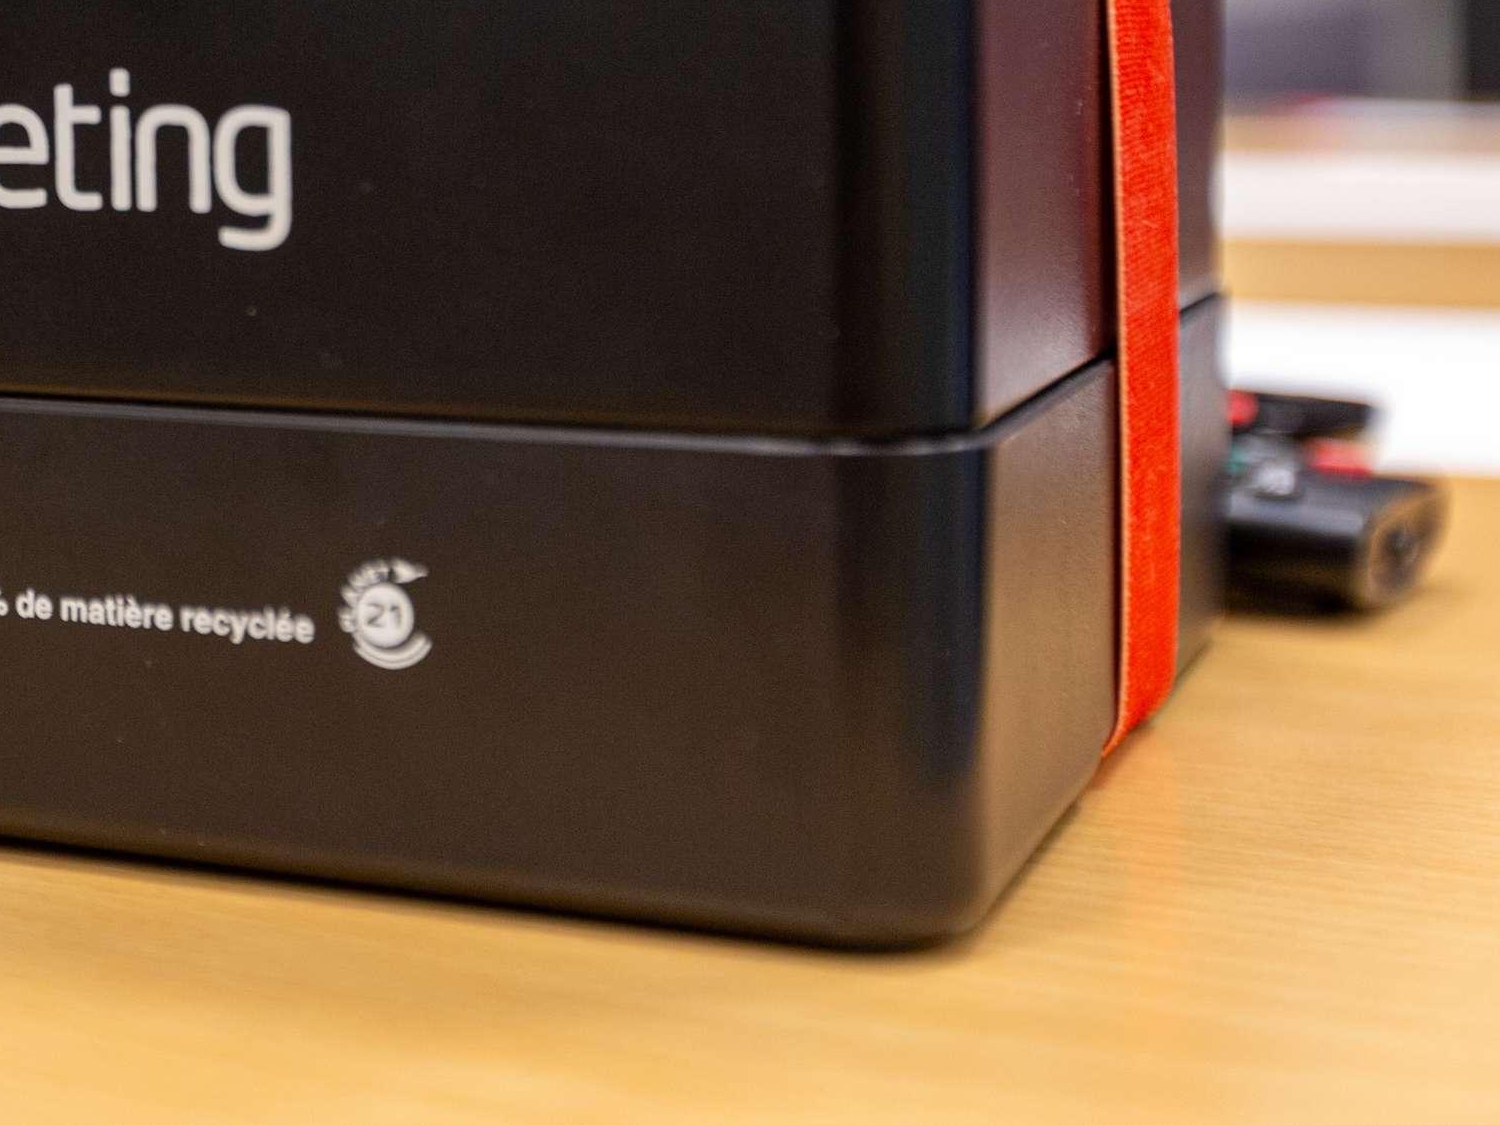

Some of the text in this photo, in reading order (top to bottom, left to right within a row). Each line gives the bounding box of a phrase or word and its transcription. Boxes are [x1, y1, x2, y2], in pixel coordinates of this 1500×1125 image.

[15, 588, 53, 620] de
[59, 595, 174, 631] matière
[179, 607, 315, 645] recyclée
[366, 602, 402, 630] 21
